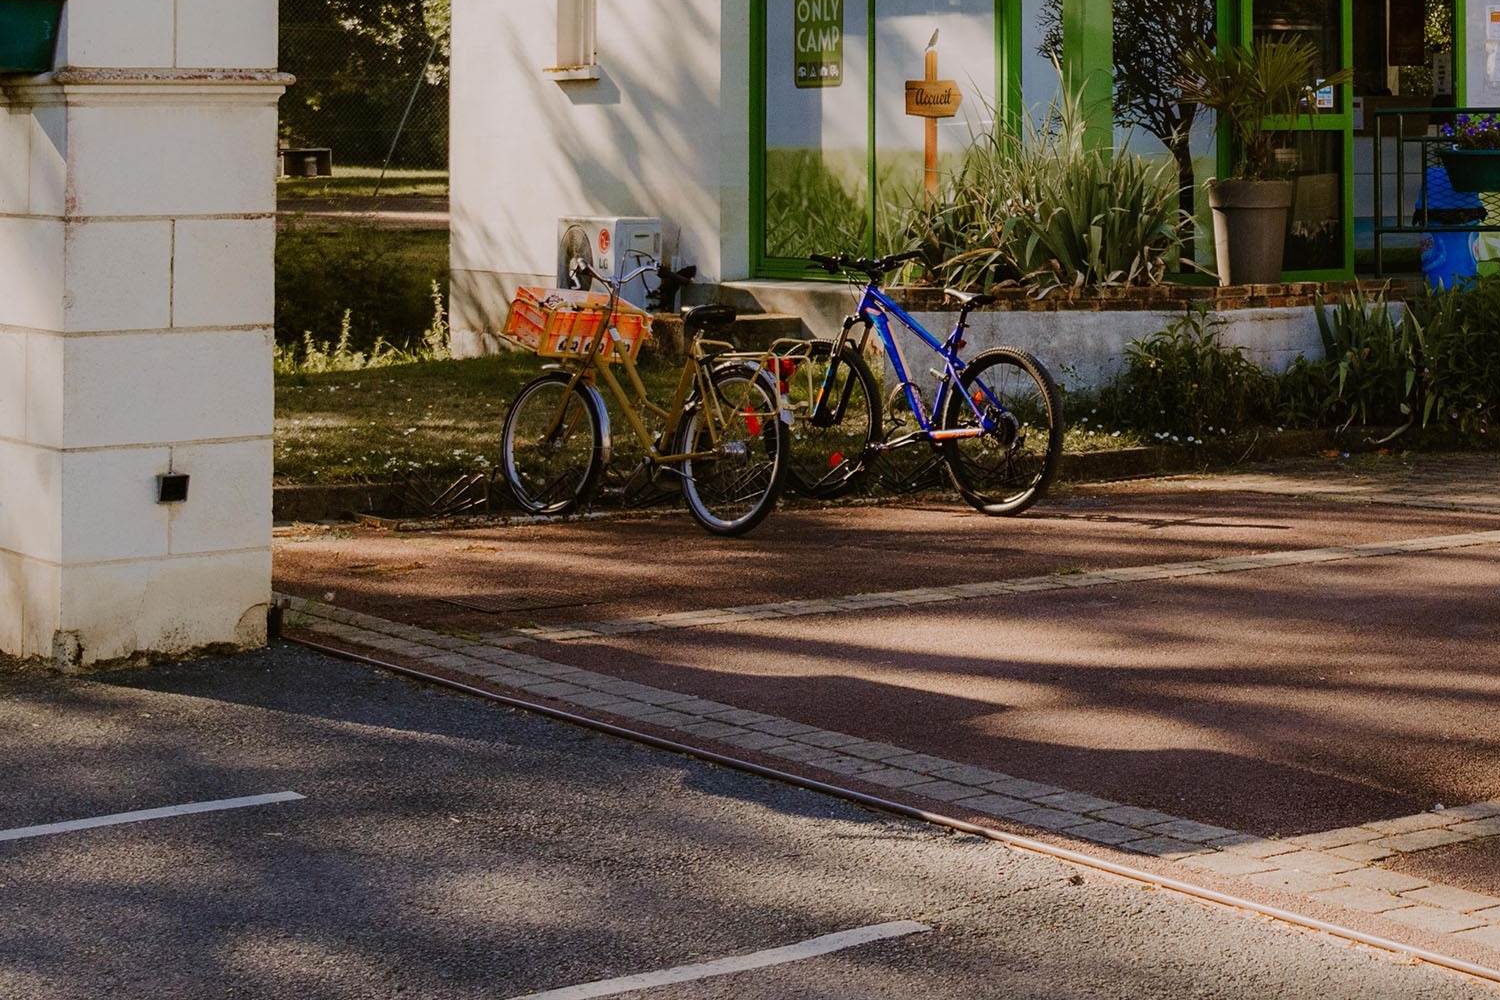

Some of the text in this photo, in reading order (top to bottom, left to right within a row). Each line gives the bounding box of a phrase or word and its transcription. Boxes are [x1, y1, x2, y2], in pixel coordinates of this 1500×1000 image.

[797, 25, 839, 53] CAMP
[915, 87, 952, 106] Accueil
[599, 257, 608, 270] LG
